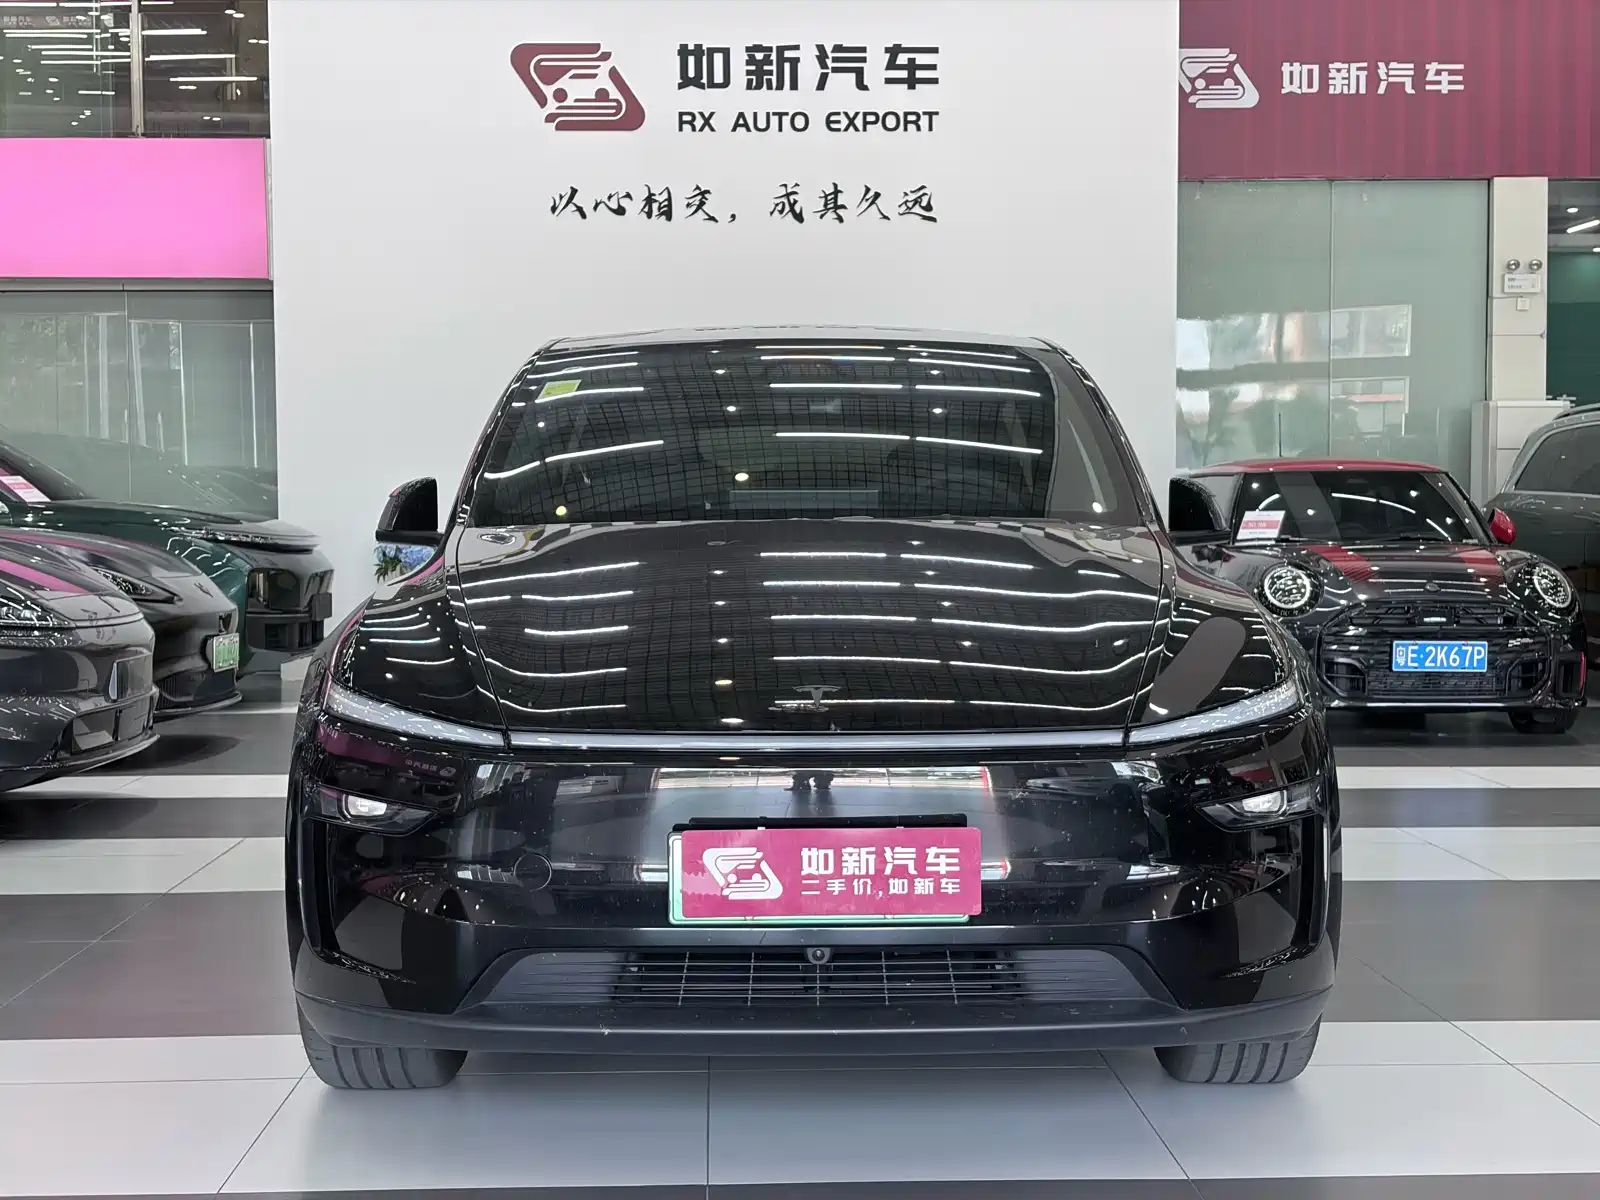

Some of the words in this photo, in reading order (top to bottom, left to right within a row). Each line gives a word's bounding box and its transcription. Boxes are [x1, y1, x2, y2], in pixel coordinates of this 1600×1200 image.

[678, 43, 940, 92] 如新汽车
[1280, 61, 1465, 95] 如新汽车
[678, 111, 716, 133] RX
[730, 111, 810, 133] AUTO
[825, 111, 940, 133] EXPORT
[800, 846, 961, 876] 如新汽车
